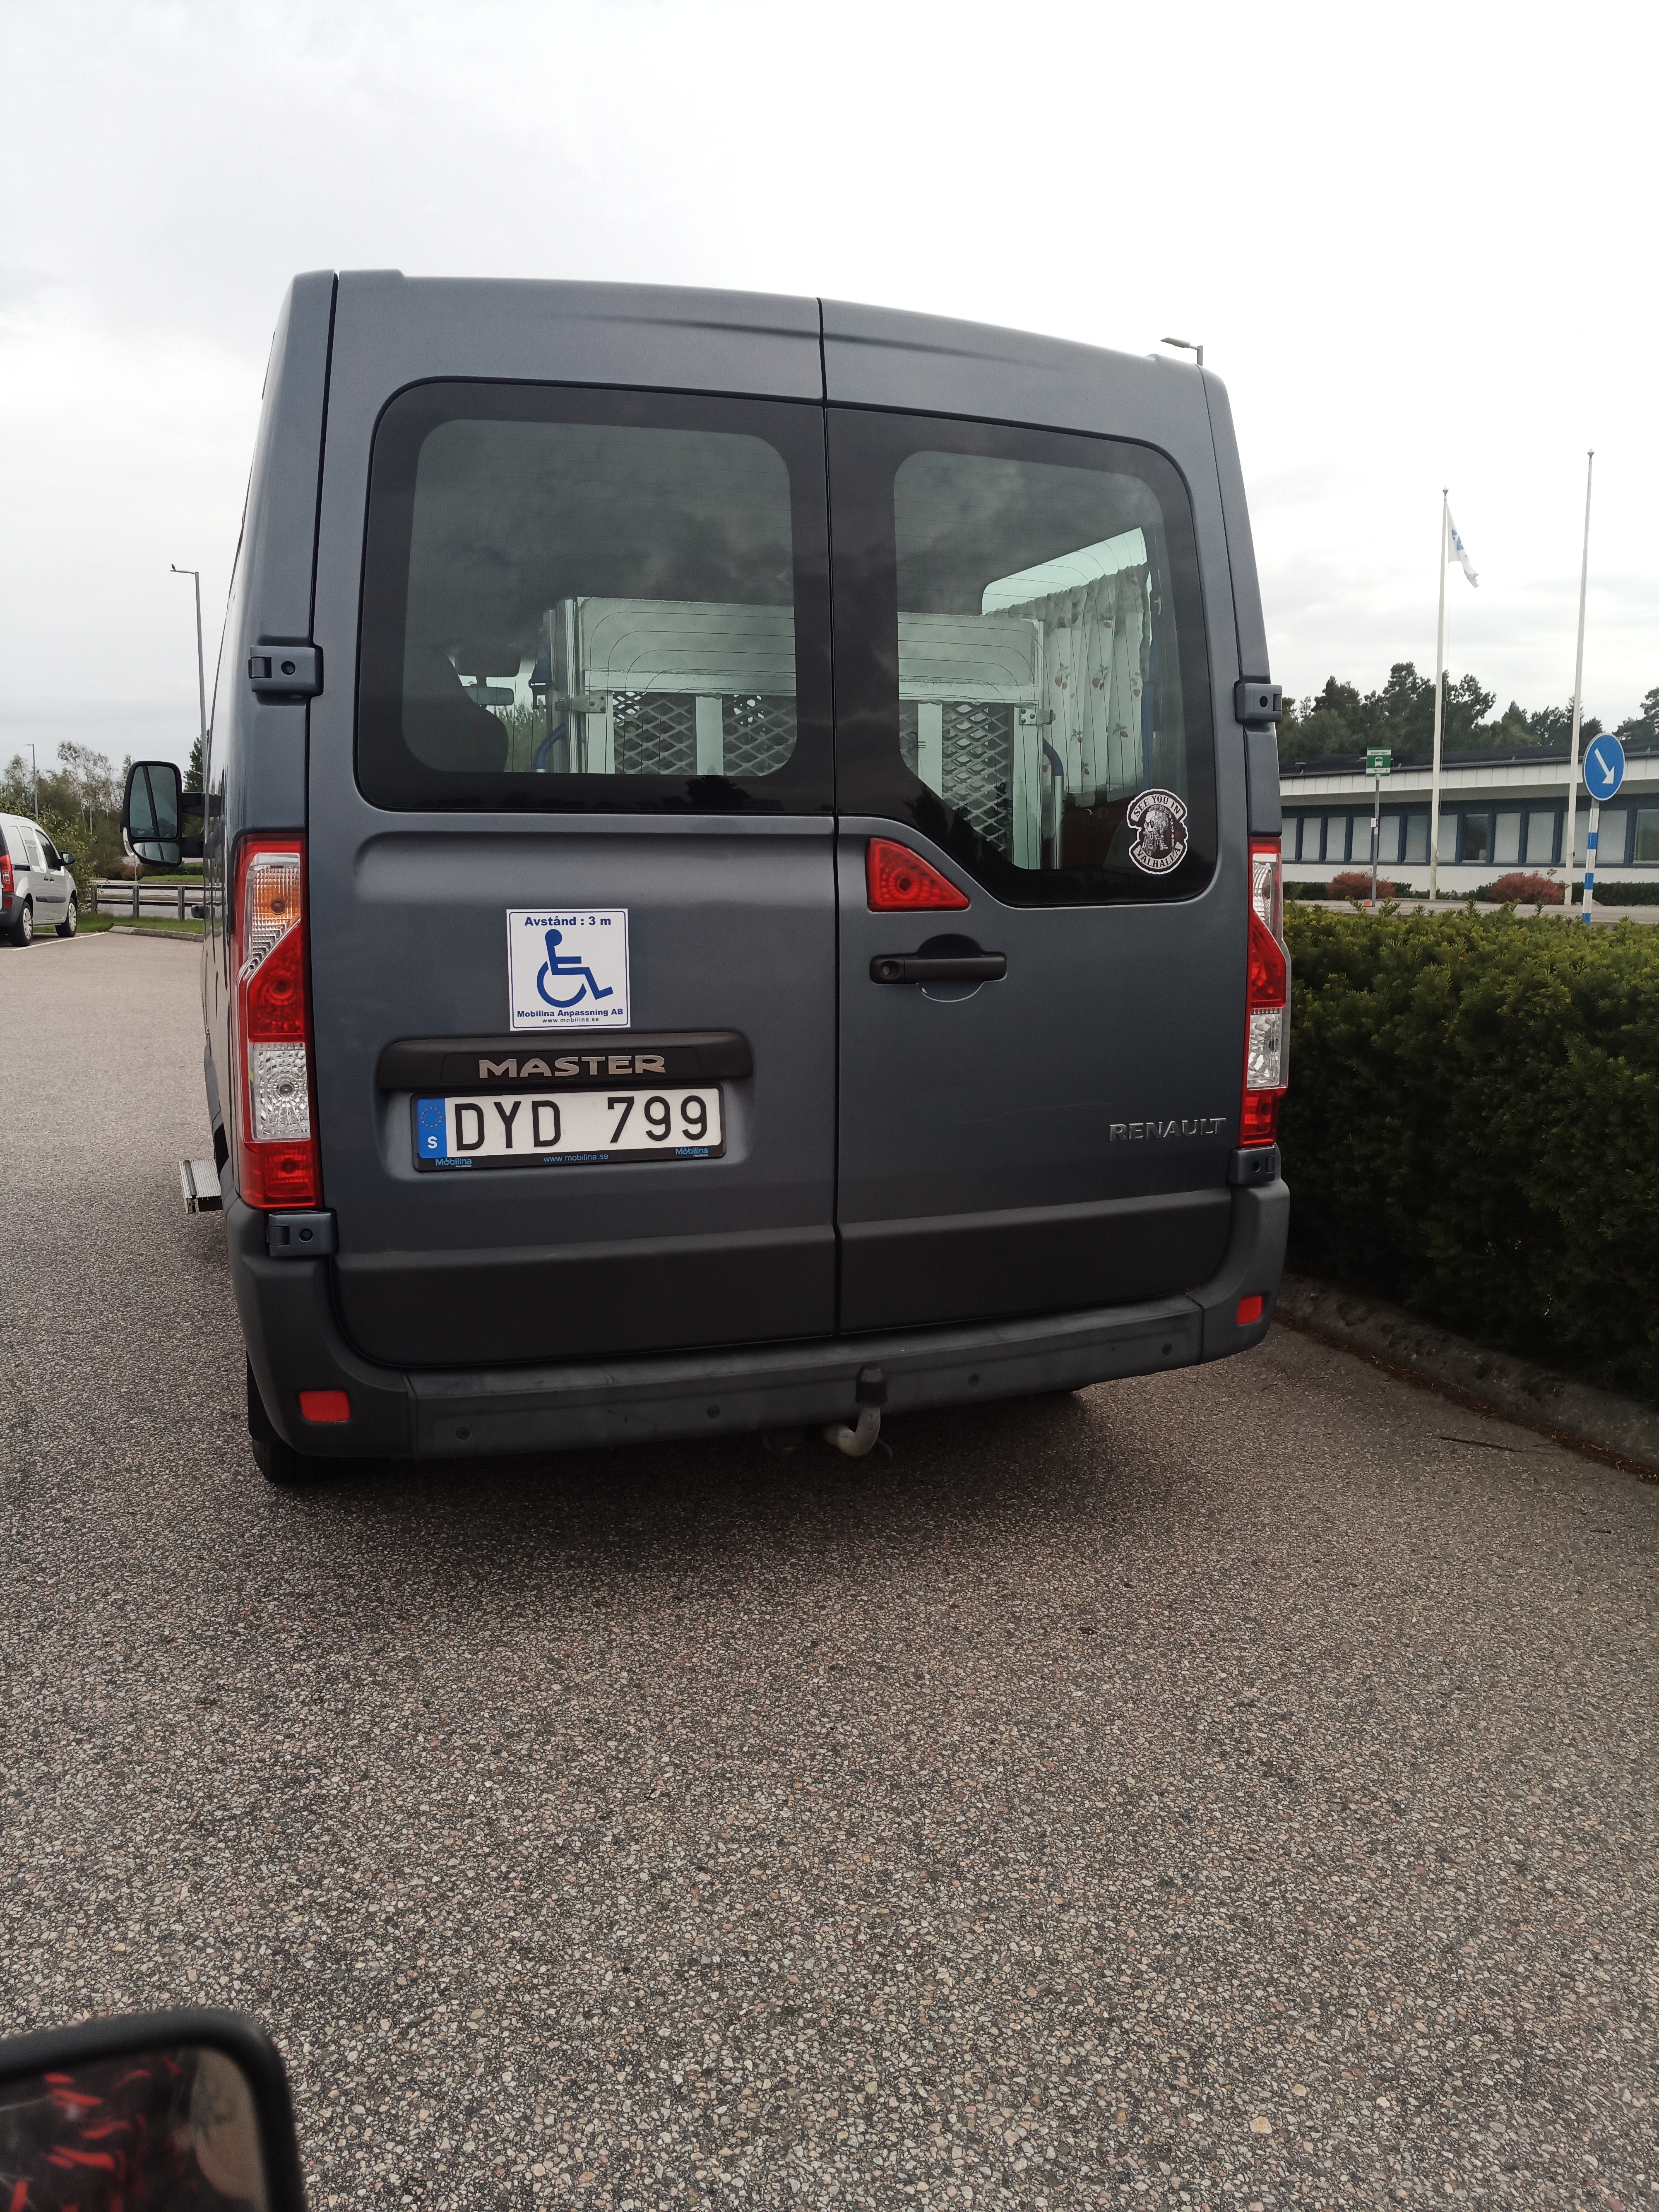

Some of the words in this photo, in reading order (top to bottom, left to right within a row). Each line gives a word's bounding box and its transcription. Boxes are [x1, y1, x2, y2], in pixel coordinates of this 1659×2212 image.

[1134, 798, 1149, 818] SEE
[1152, 795, 1169, 805] YOU
[1171, 802, 1181, 814] IN
[1137, 848, 1181, 868] VALHALLA
[524, 916, 576, 926] Avstånd
[589, 916, 596, 926] 3
[558, 1009, 608, 1017] Anpassning
[479, 1055, 666, 1078] MASTER
[455, 1100, 562, 1152] DYD
[607, 1096, 708, 1144] 799
[1109, 1118, 1226, 1141] RENAULT
[428, 1136, 438, 1149] S
[543, 1153, 608, 1162] www.mobilina.se
